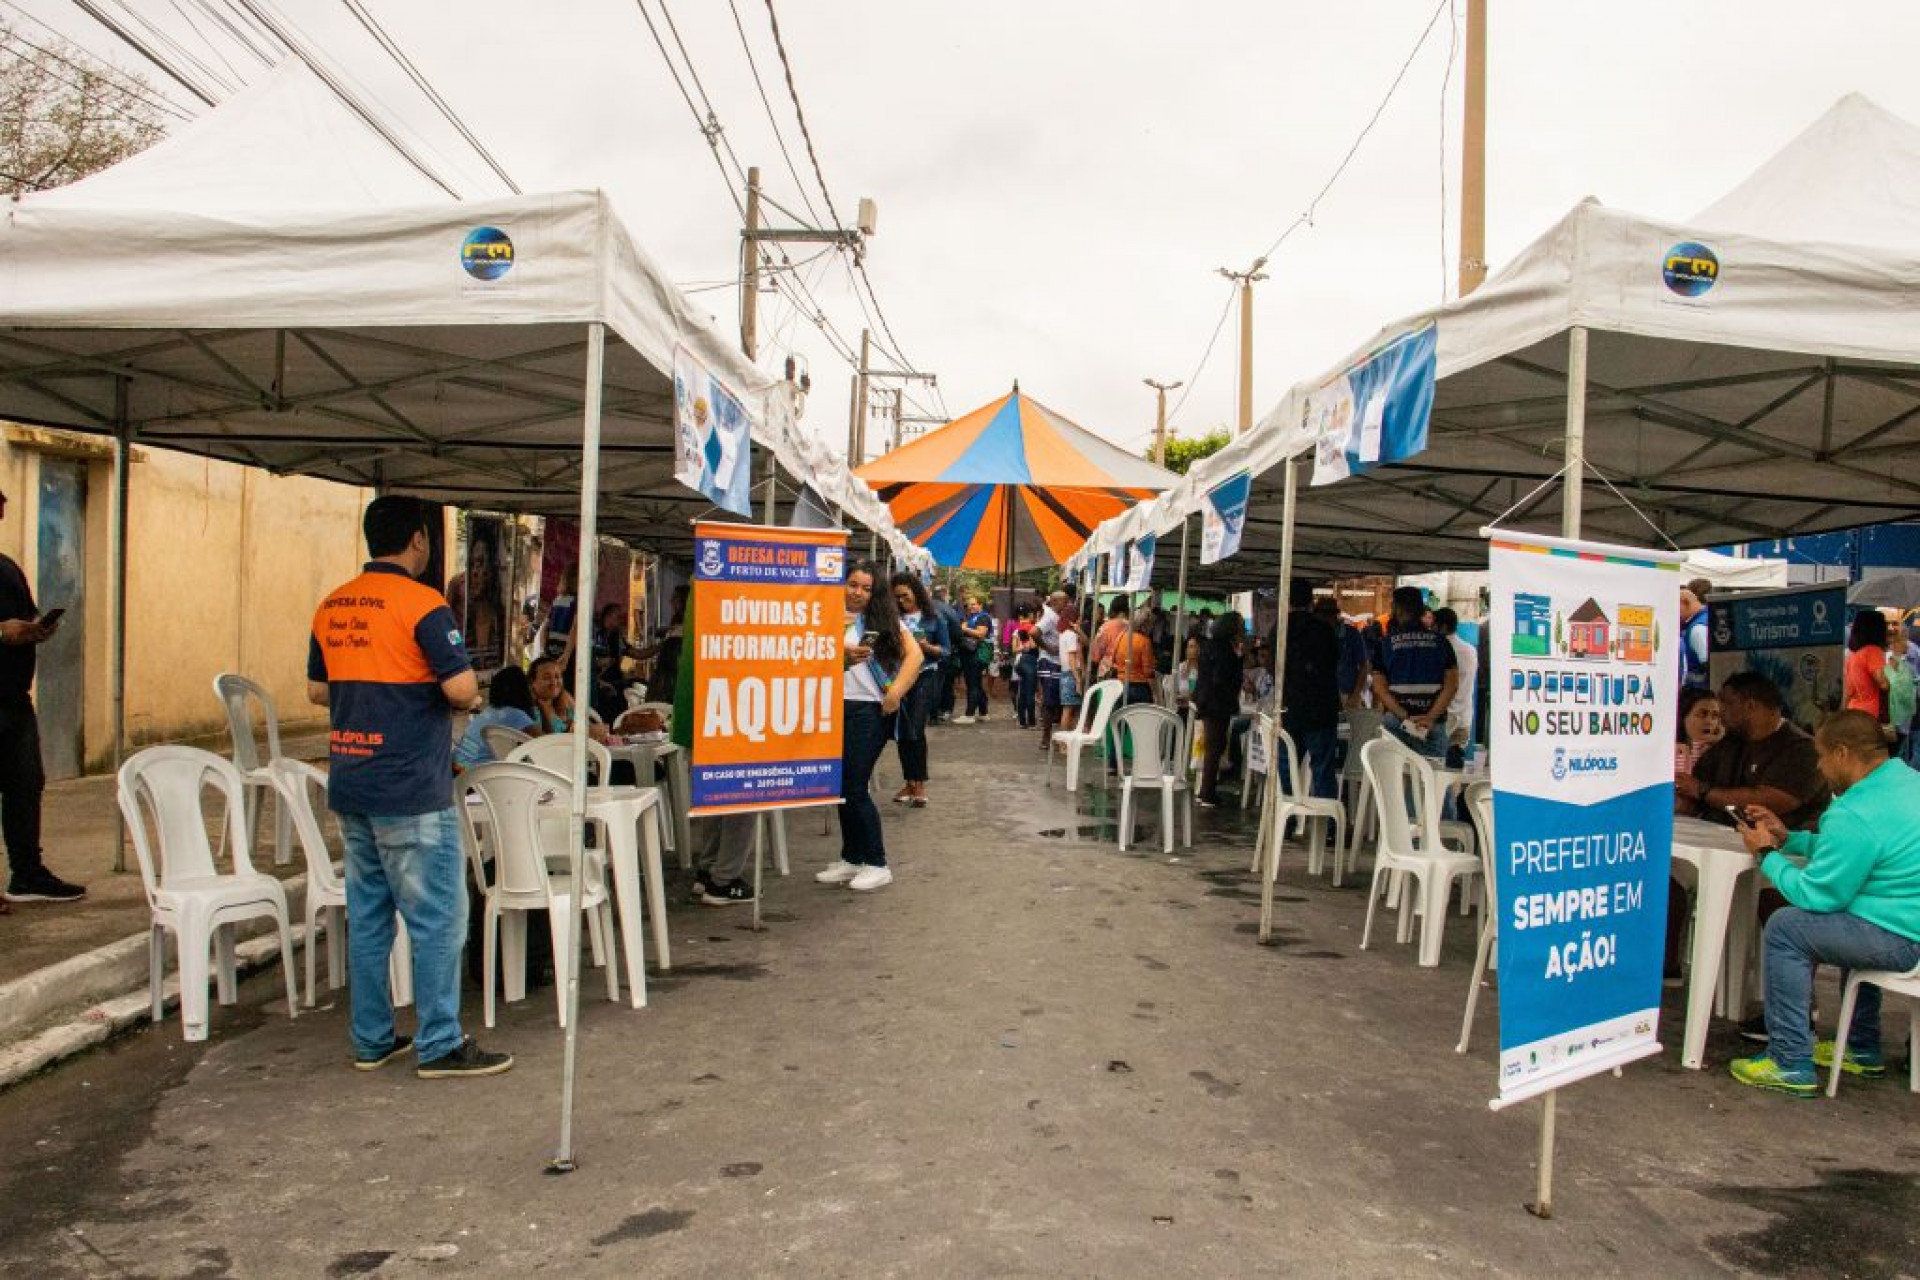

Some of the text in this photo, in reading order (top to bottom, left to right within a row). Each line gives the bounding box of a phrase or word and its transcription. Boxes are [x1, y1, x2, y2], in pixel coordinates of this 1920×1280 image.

[727, 546, 809, 566] DEFESA CIVIL
[730, 565, 762, 576] PERTO
[764, 567, 777, 577] DE
[359, 597, 385, 609] CIVIL
[721, 595, 821, 625] DÚVIDAS E
[1749, 623, 1799, 640] Turismo
[701, 631, 836, 666] INFORMAÇÕES
[1509, 669, 1655, 705] PREFEITURA
[1510, 709, 1653, 735] NO SEU BAIRRO
[1569, 753, 1617, 771] NILÓPOLIS
[1511, 830, 1647, 875] PREFEITURA
[1513, 880, 1643, 930] SEMPRE EM
[1545, 930, 1616, 983] AÇÃO!
